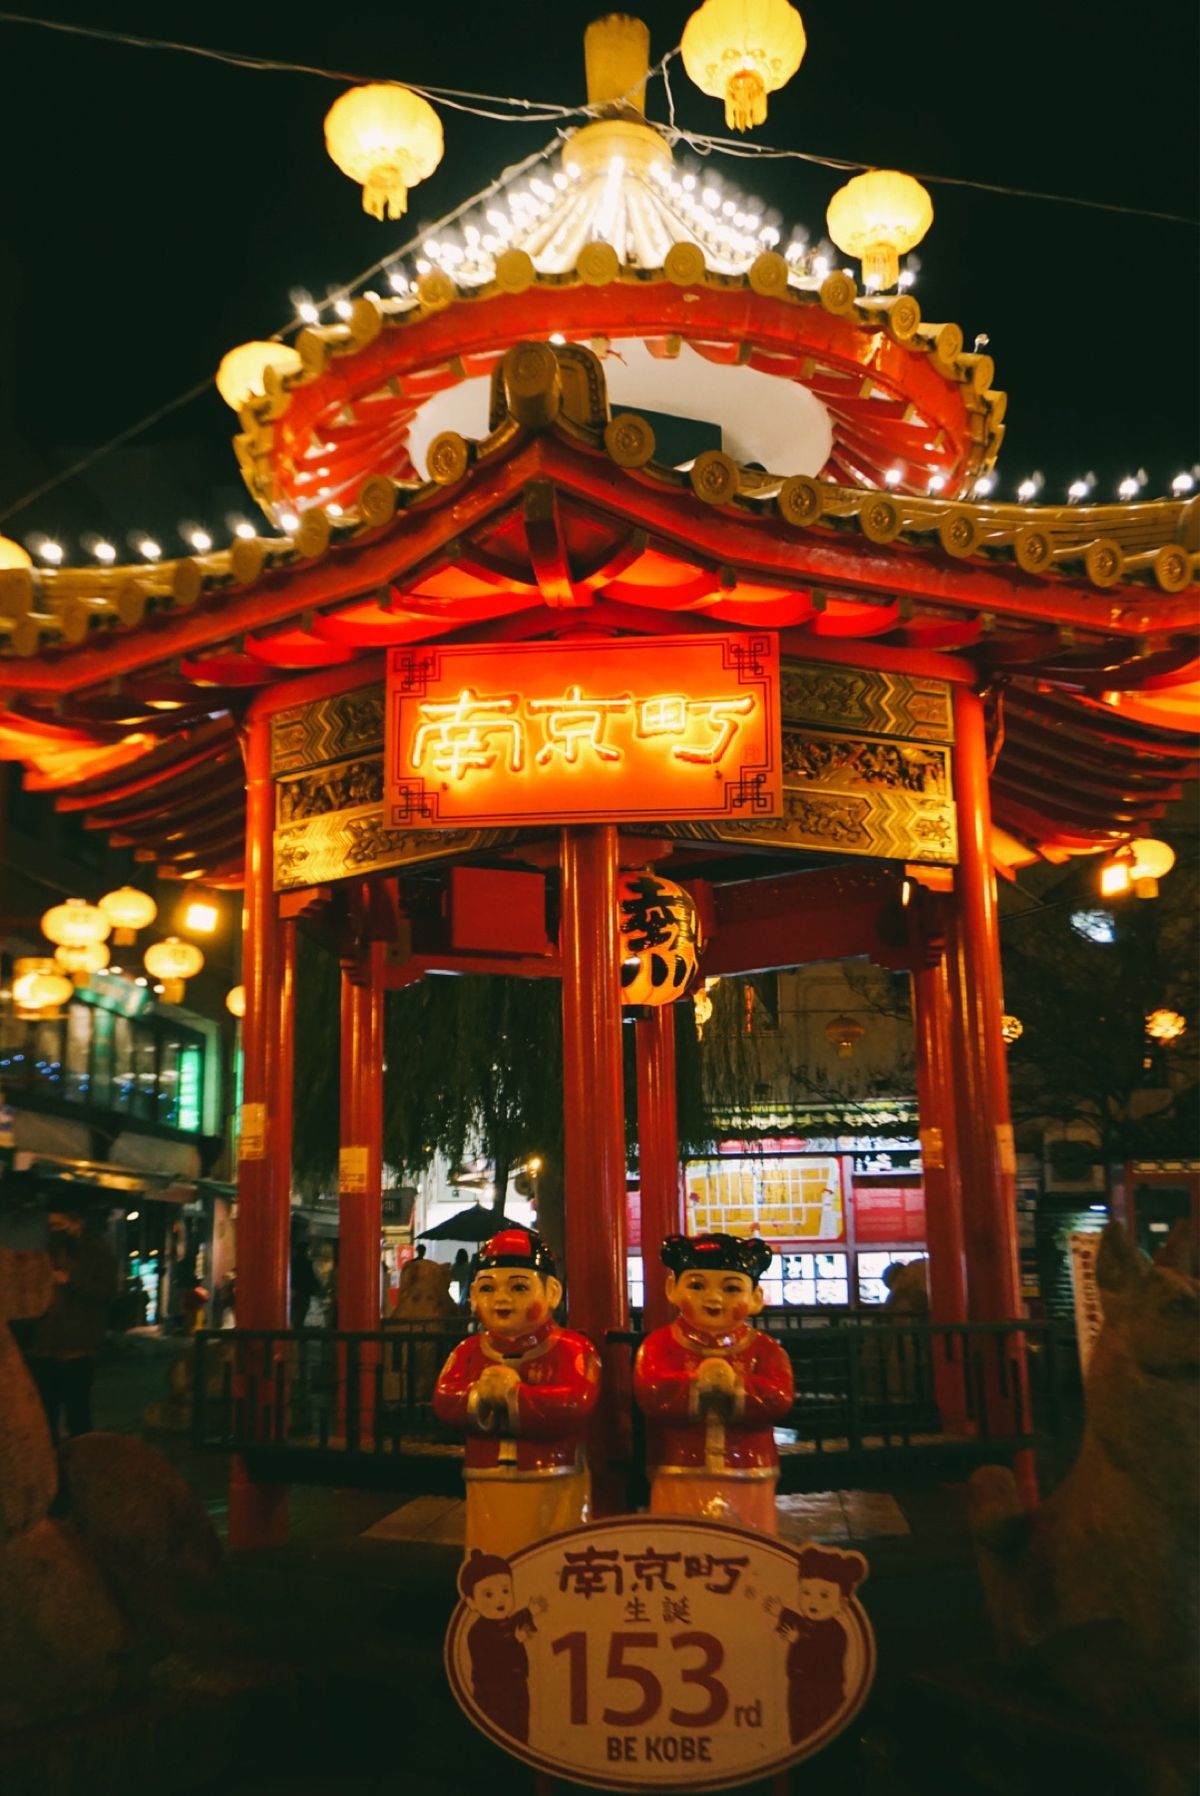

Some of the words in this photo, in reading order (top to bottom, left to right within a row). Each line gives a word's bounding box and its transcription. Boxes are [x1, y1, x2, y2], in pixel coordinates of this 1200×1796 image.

[411, 686, 755, 780] 南京町
[559, 1546, 750, 1600] 南京町
[624, 1597, 692, 1625] 生誕
[607, 1737, 635, 1762] BE
[645, 1736, 712, 1762] KOBE
